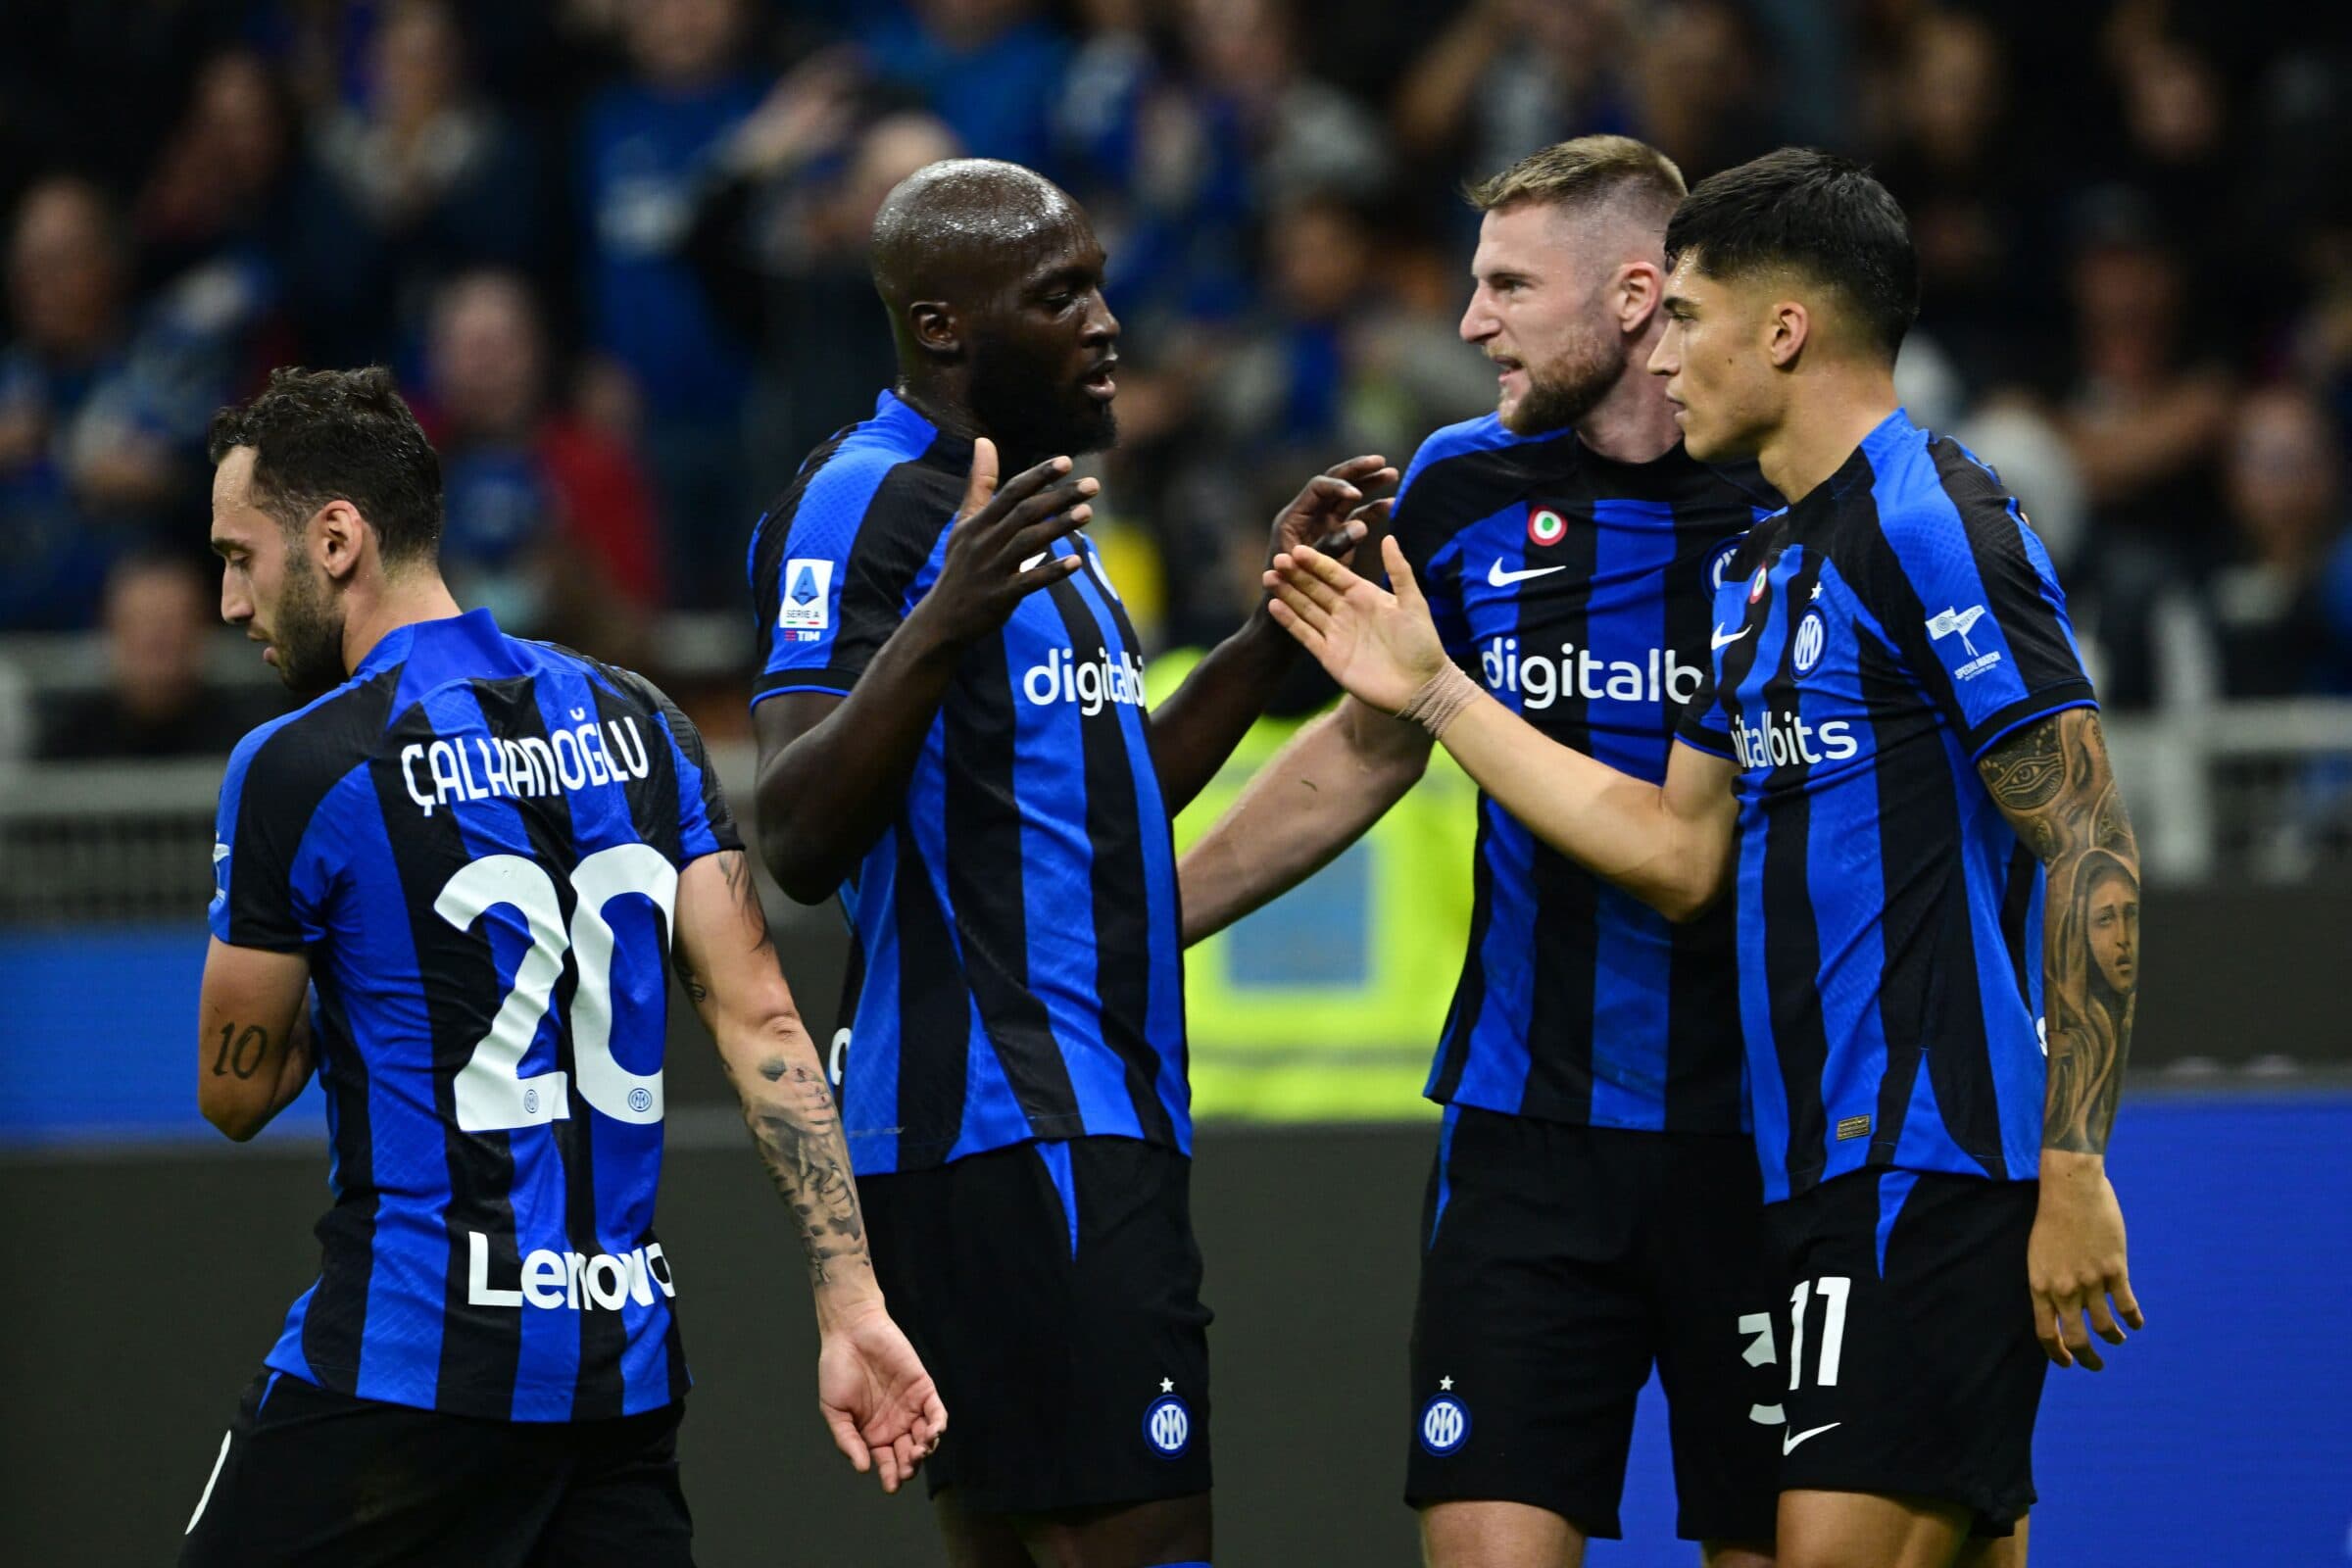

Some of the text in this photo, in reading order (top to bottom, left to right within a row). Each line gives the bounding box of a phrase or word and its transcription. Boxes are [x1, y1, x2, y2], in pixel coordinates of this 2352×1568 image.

[796, 630, 821, 642] TIM
[401, 707, 650, 817] ÇALHANOĞLU
[1730, 710, 1859, 768] italbits
[433, 842, 678, 1133] 20
[213, 1021, 269, 1080] 10
[467, 1230, 676, 1311] Lenovo
[1788, 1276, 1851, 1391] 11
